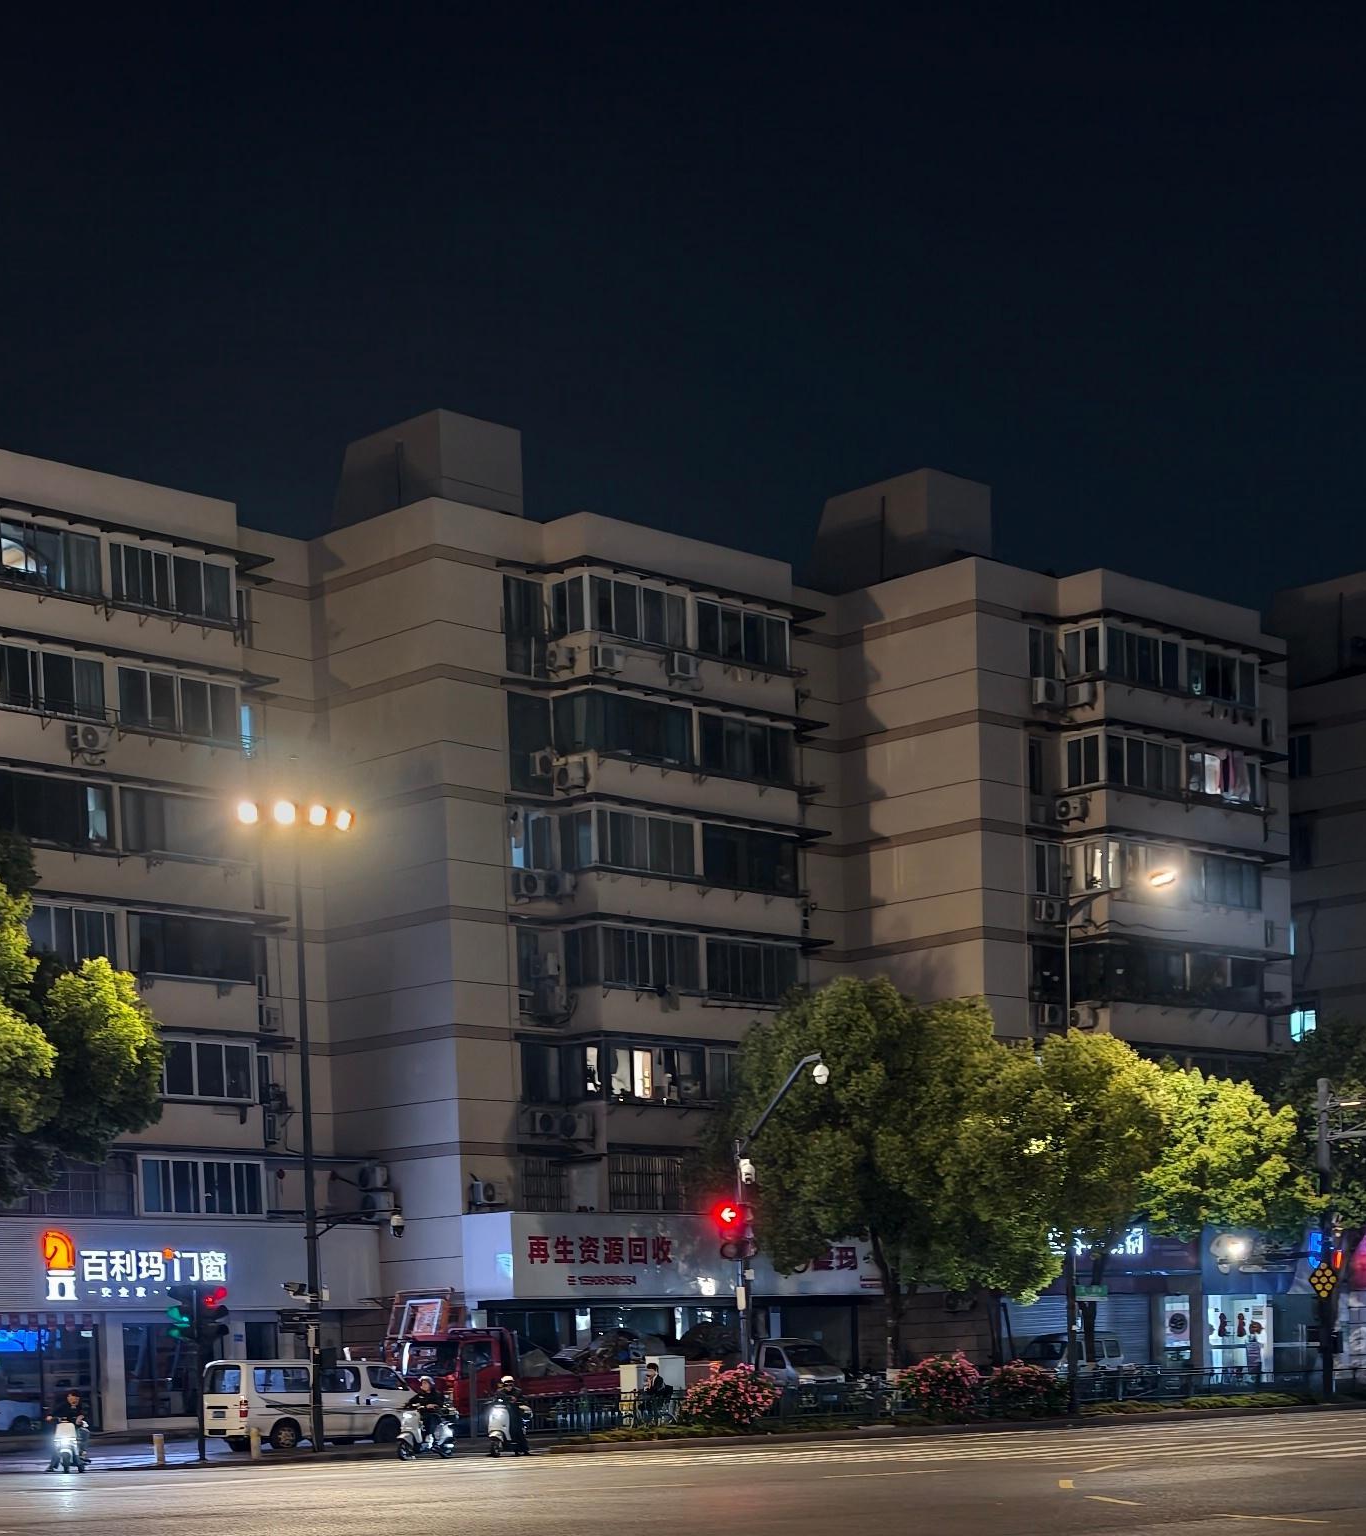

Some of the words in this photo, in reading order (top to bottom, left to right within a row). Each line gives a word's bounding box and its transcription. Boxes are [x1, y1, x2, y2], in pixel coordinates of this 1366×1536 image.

[528, 1236, 673, 1265] 再生资源回收
